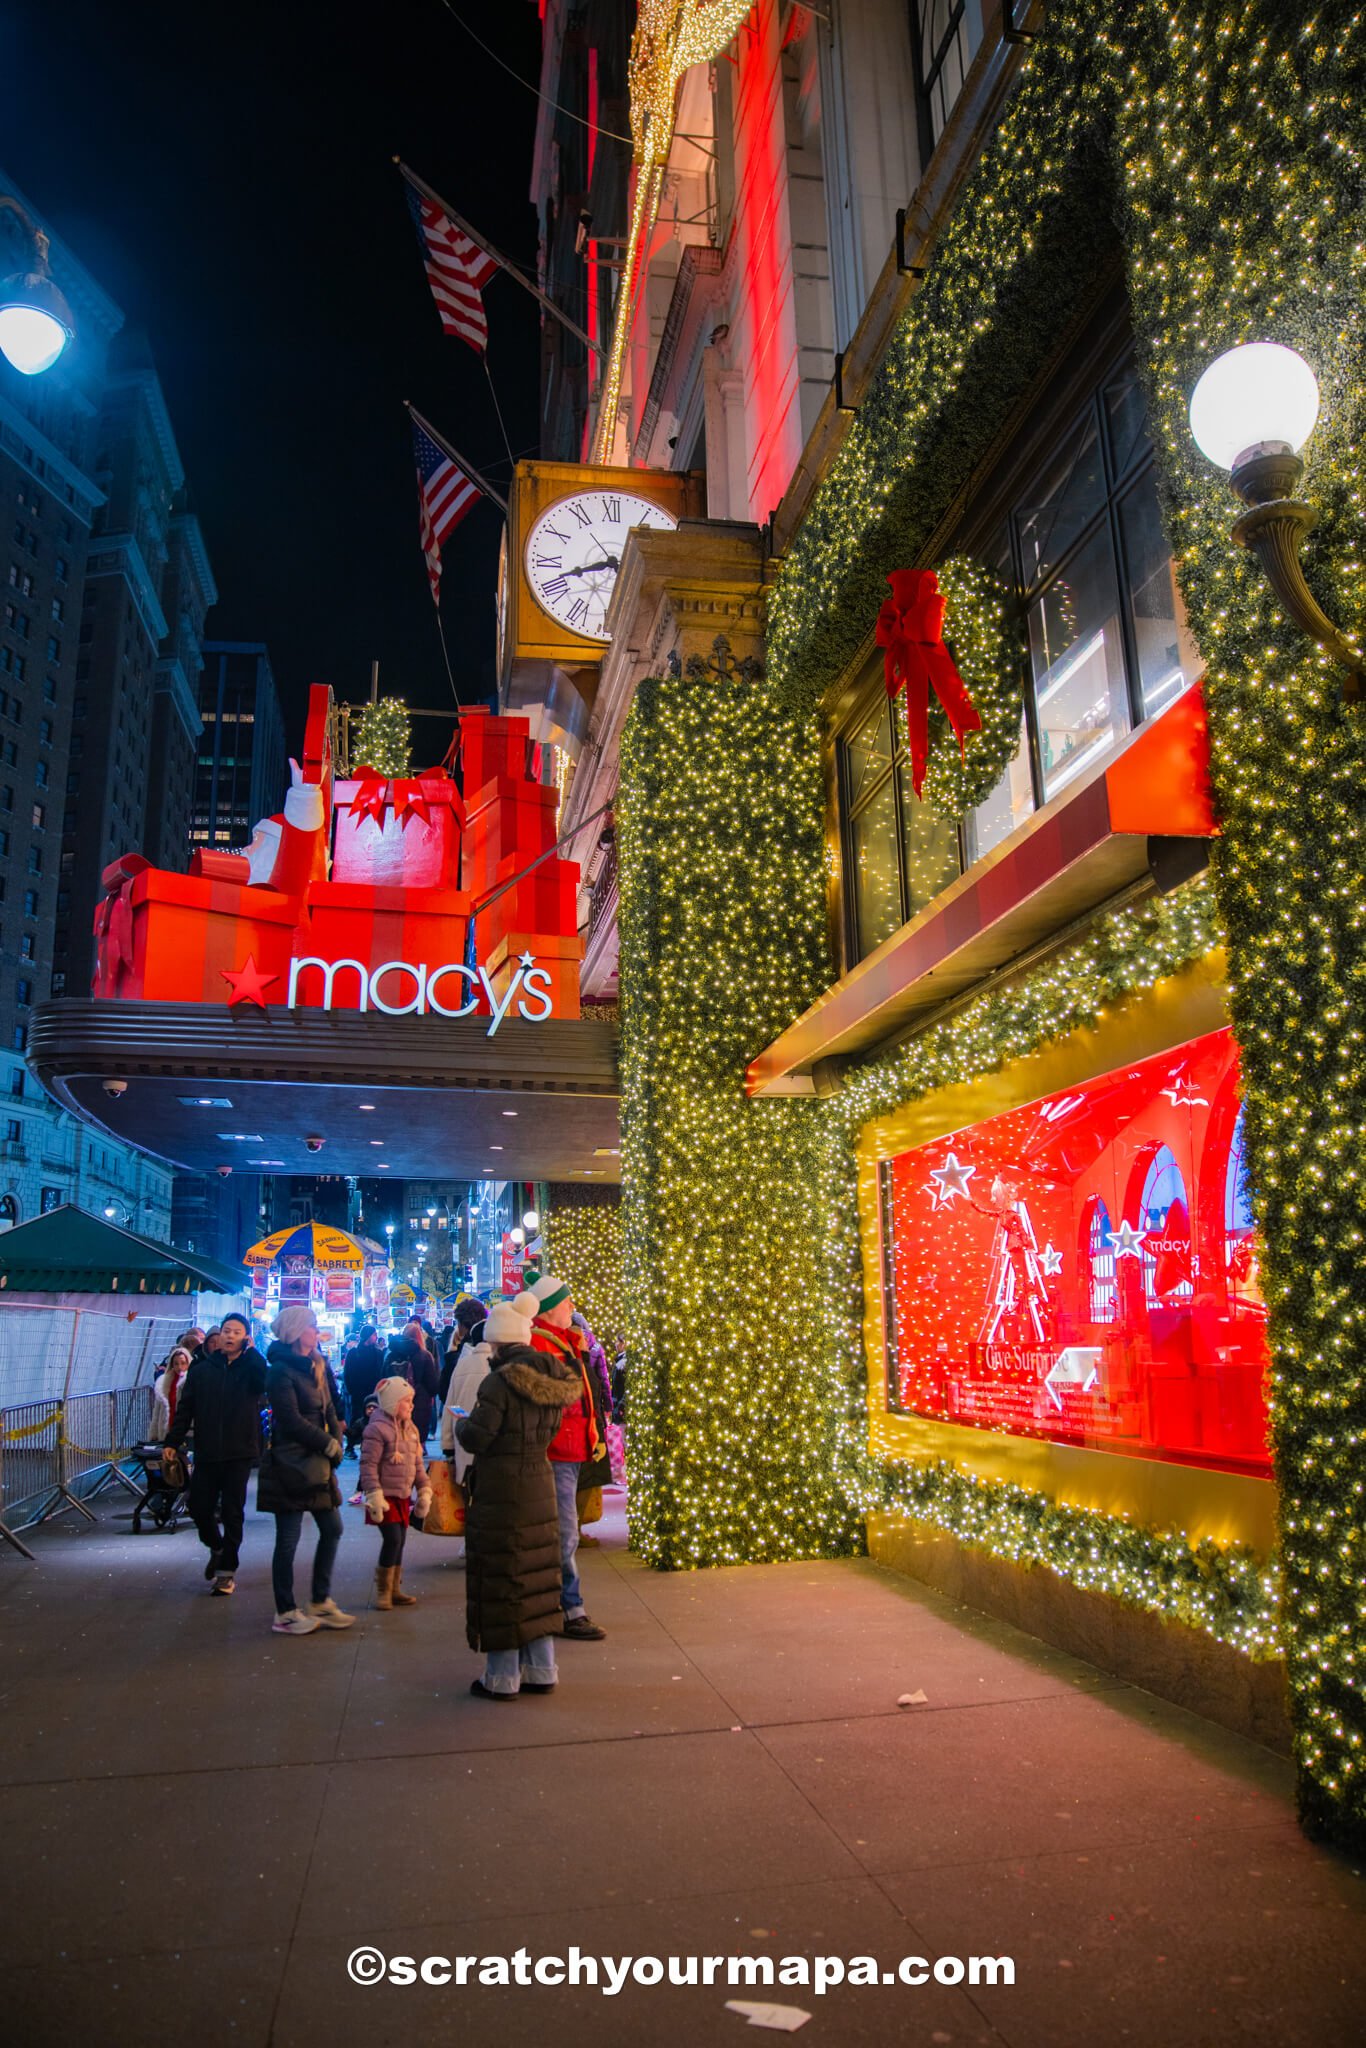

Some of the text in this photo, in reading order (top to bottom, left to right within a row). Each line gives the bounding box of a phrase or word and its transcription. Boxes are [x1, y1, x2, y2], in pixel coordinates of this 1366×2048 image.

[602, 500, 620, 522] XII
[246, 1254, 273, 1266] SABRETT
[316, 1259, 361, 1269] SABRETT
[503, 1266, 523, 1274] OPEN
[985, 1345, 1011, 1370] Give
